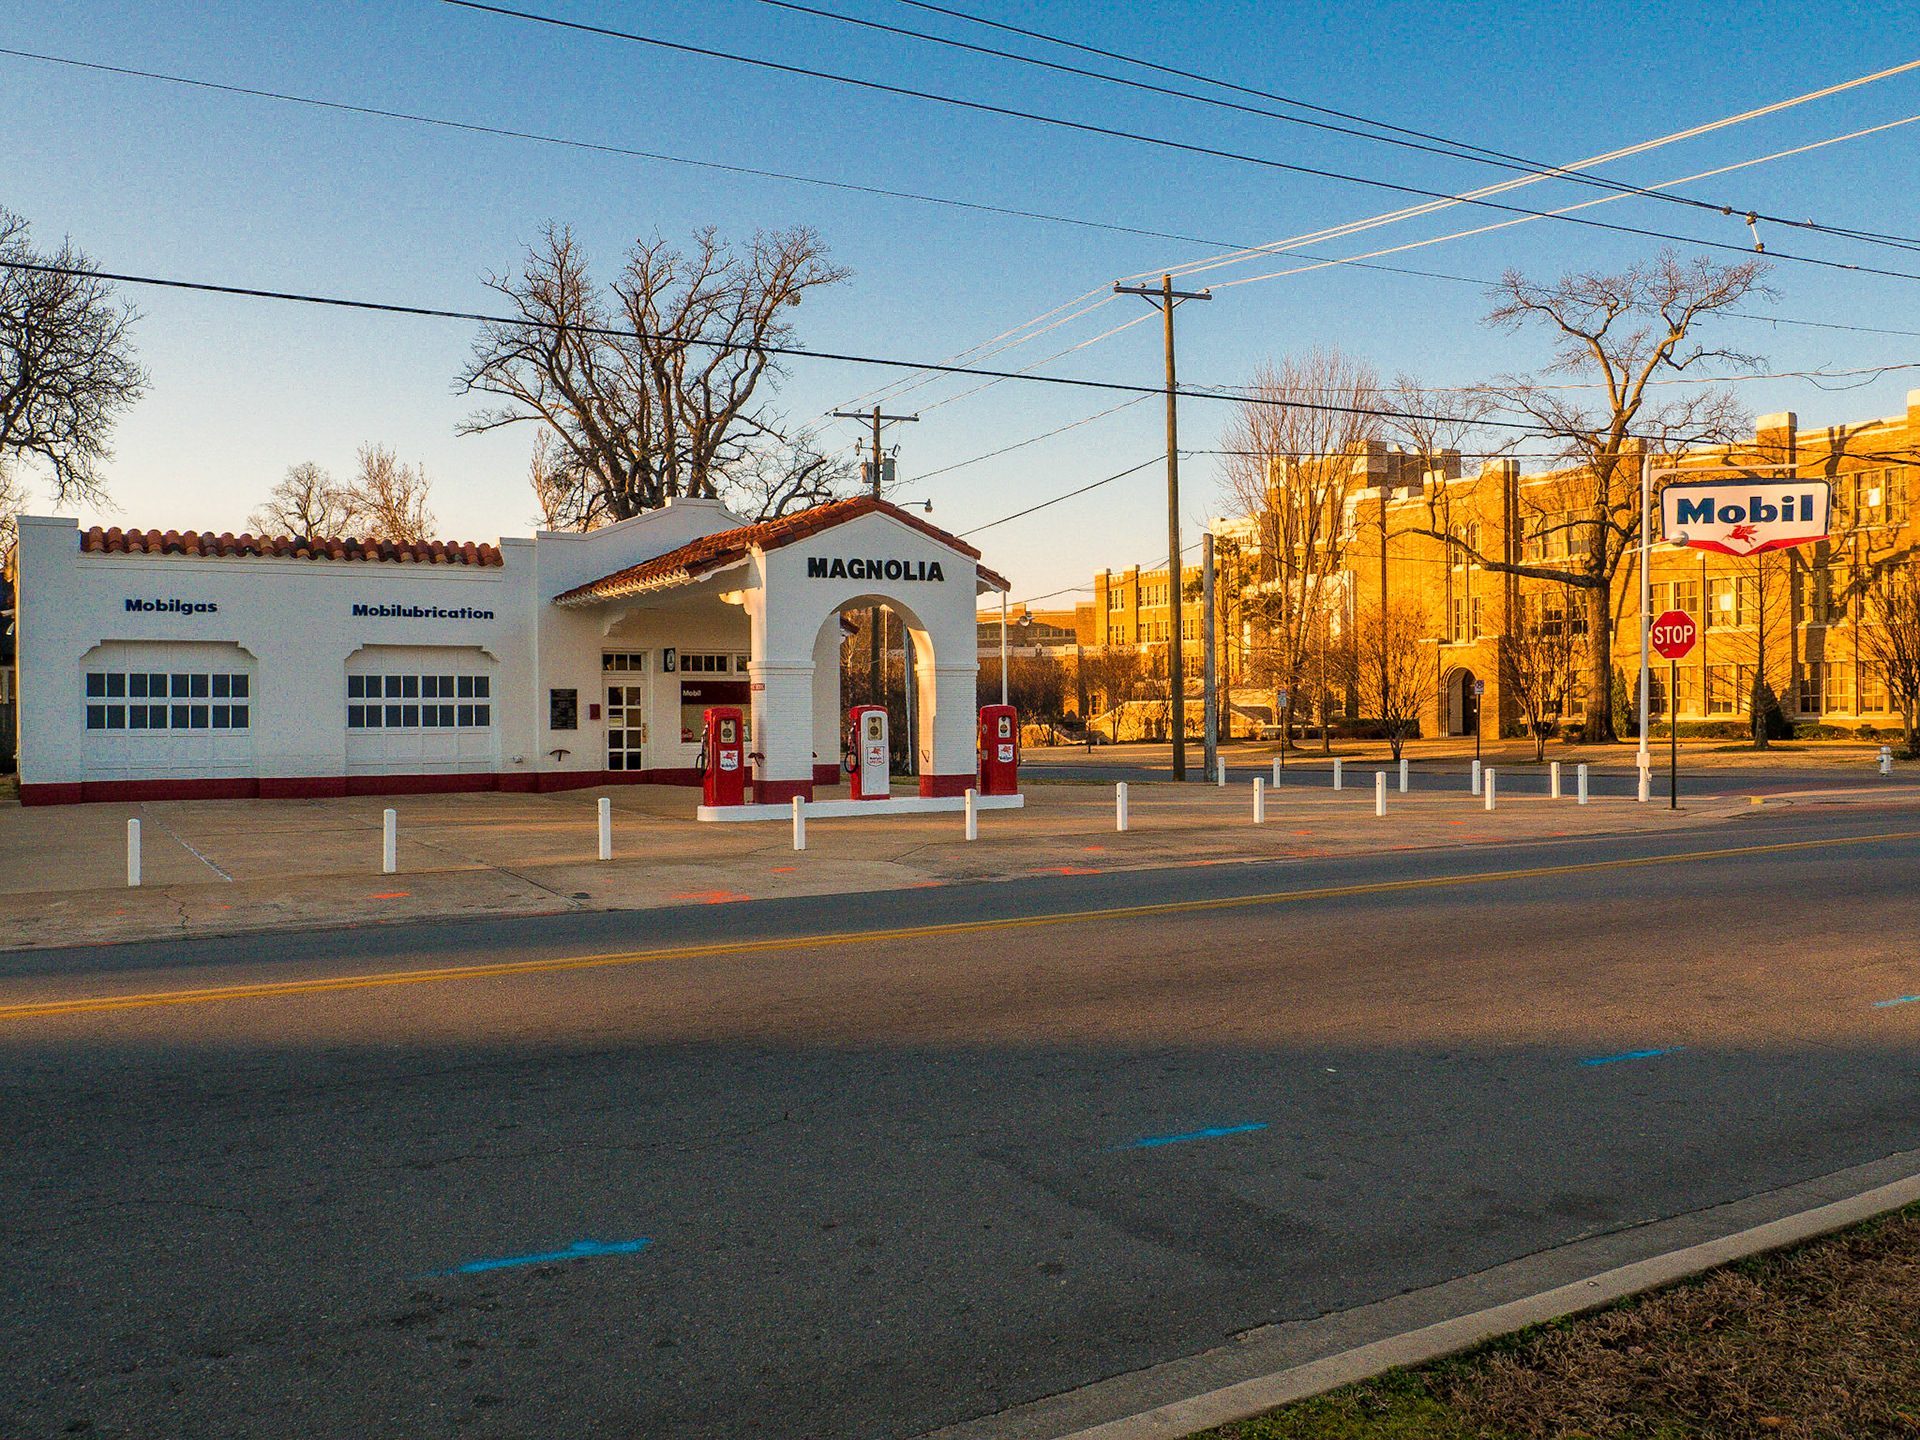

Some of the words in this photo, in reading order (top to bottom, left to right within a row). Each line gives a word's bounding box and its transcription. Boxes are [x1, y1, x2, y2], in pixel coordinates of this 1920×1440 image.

[1676, 495, 1813, 525] Mobil
[807, 557, 944, 581] MAGNOLIA
[125, 598, 218, 616] Mobilgas
[352, 604, 494, 620] Mobilubrication
[1654, 625, 1693, 644] STOP
